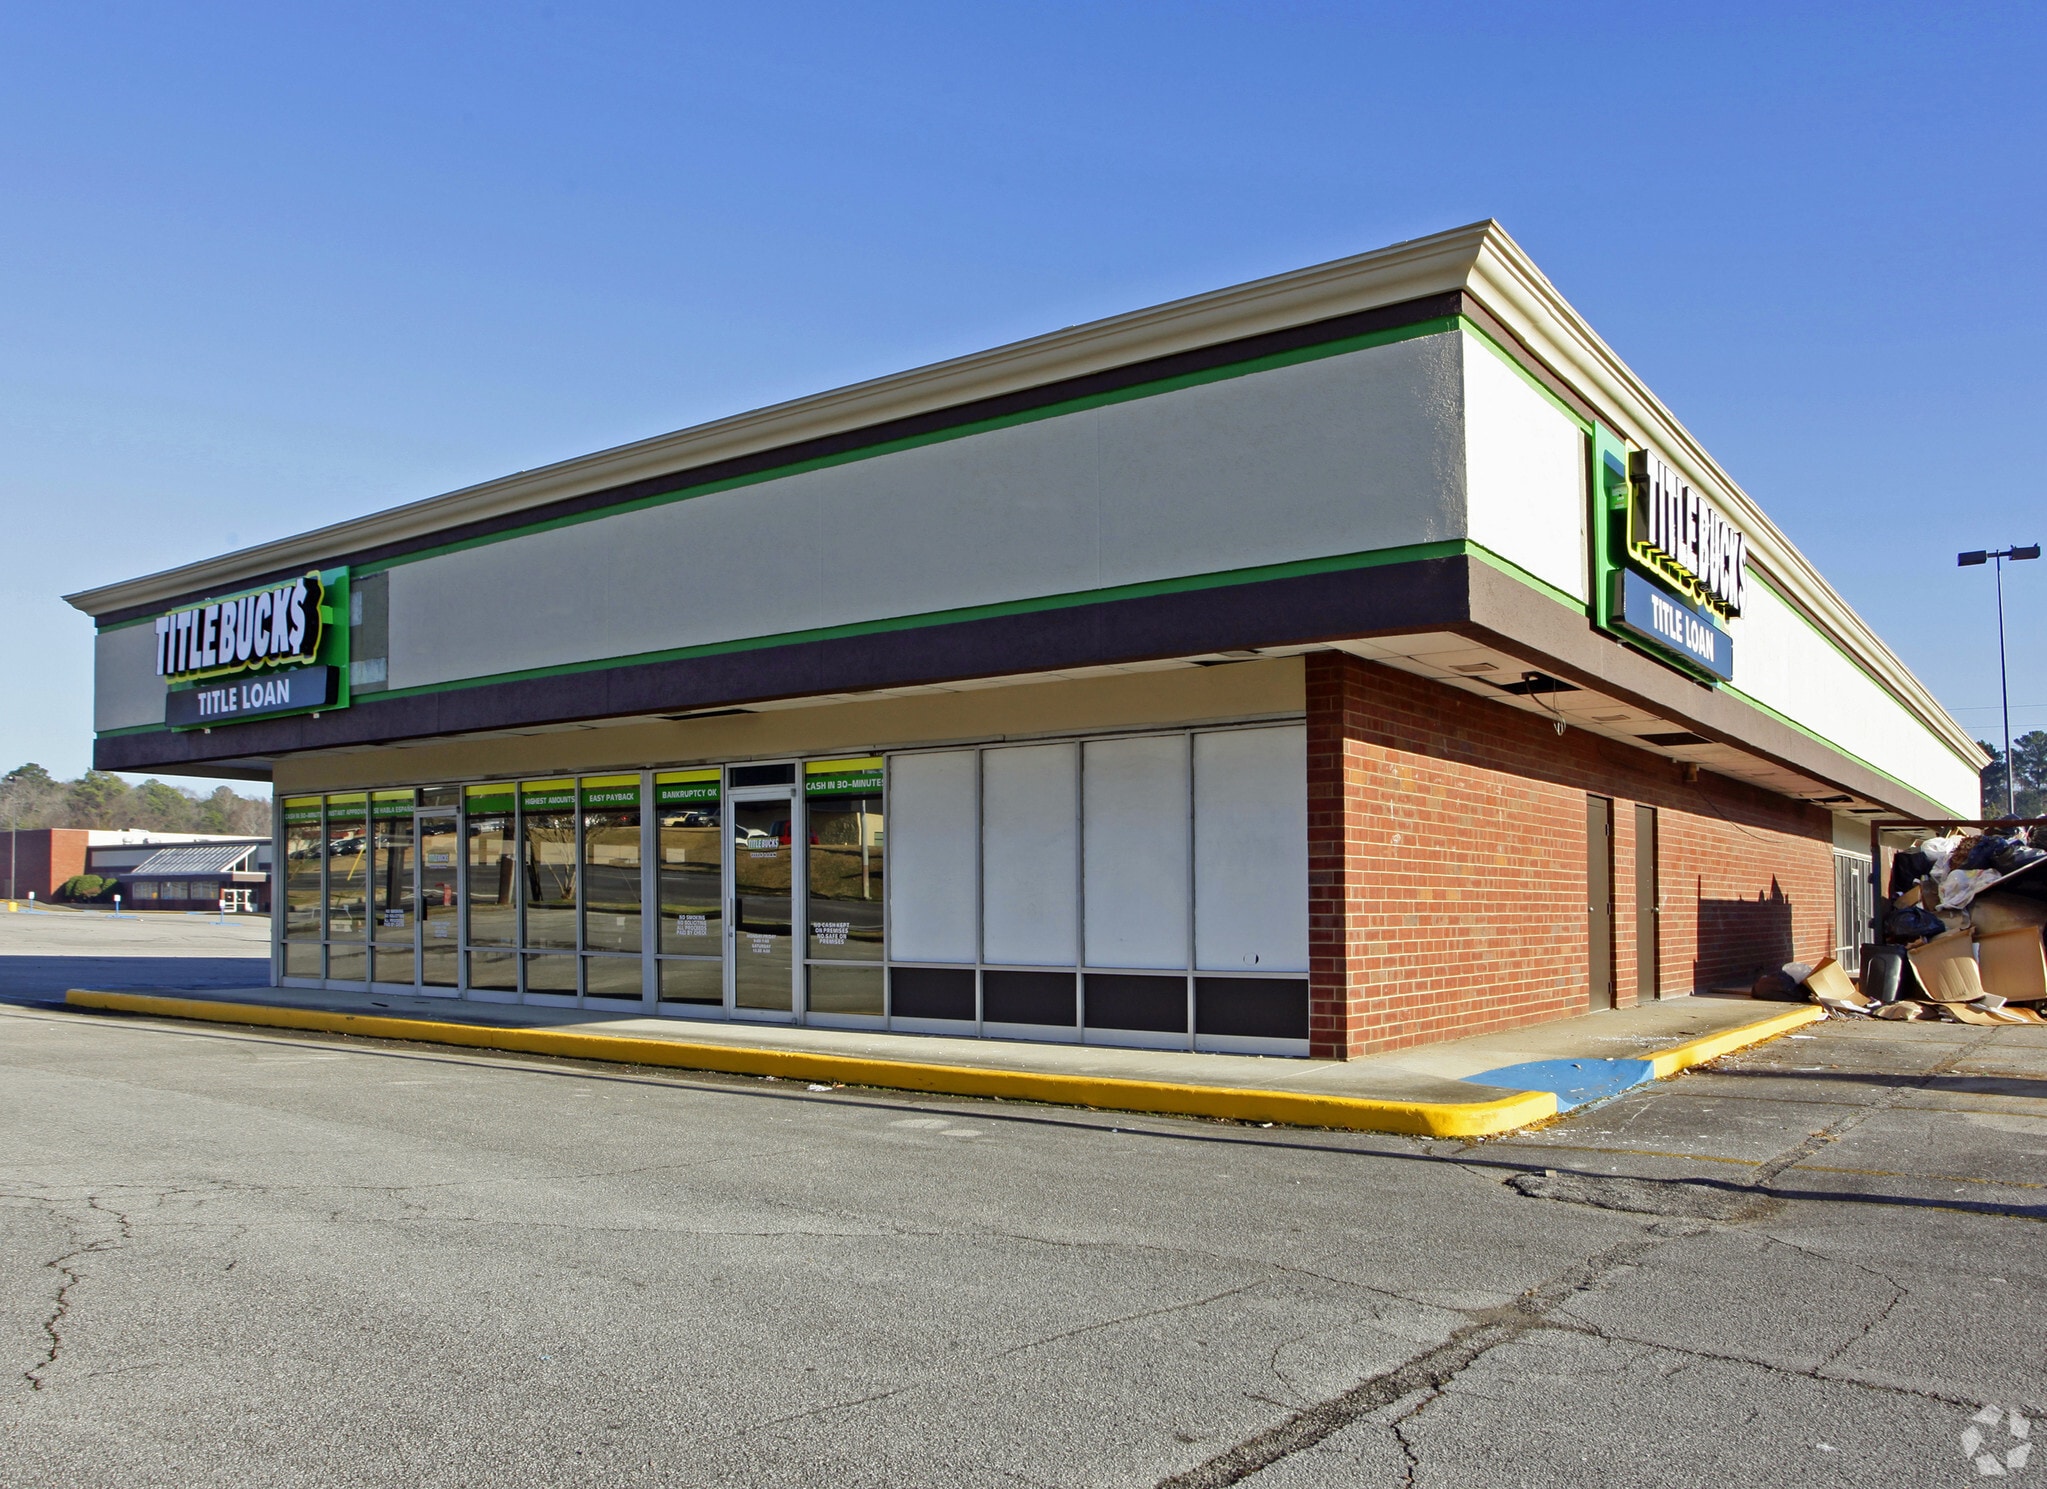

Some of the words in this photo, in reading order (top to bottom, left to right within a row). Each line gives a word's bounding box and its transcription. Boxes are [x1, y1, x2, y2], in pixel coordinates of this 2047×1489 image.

[1652, 594, 1683, 643] TITLE
[1685, 615, 1714, 663] LOAN
[198, 688, 238, 716] TITLE
[242, 678, 290, 709] LOAN
[806, 782, 826, 791] CASH
[828, 781, 835, 789] IN
[589, 794, 605, 802] EASY
[606, 793, 634, 801] PAYBACK
[662, 789, 706, 799] BANKRUPTCY
[525, 797, 547, 805] HIGHEST
[548, 795, 576, 803] AMOUNTS
